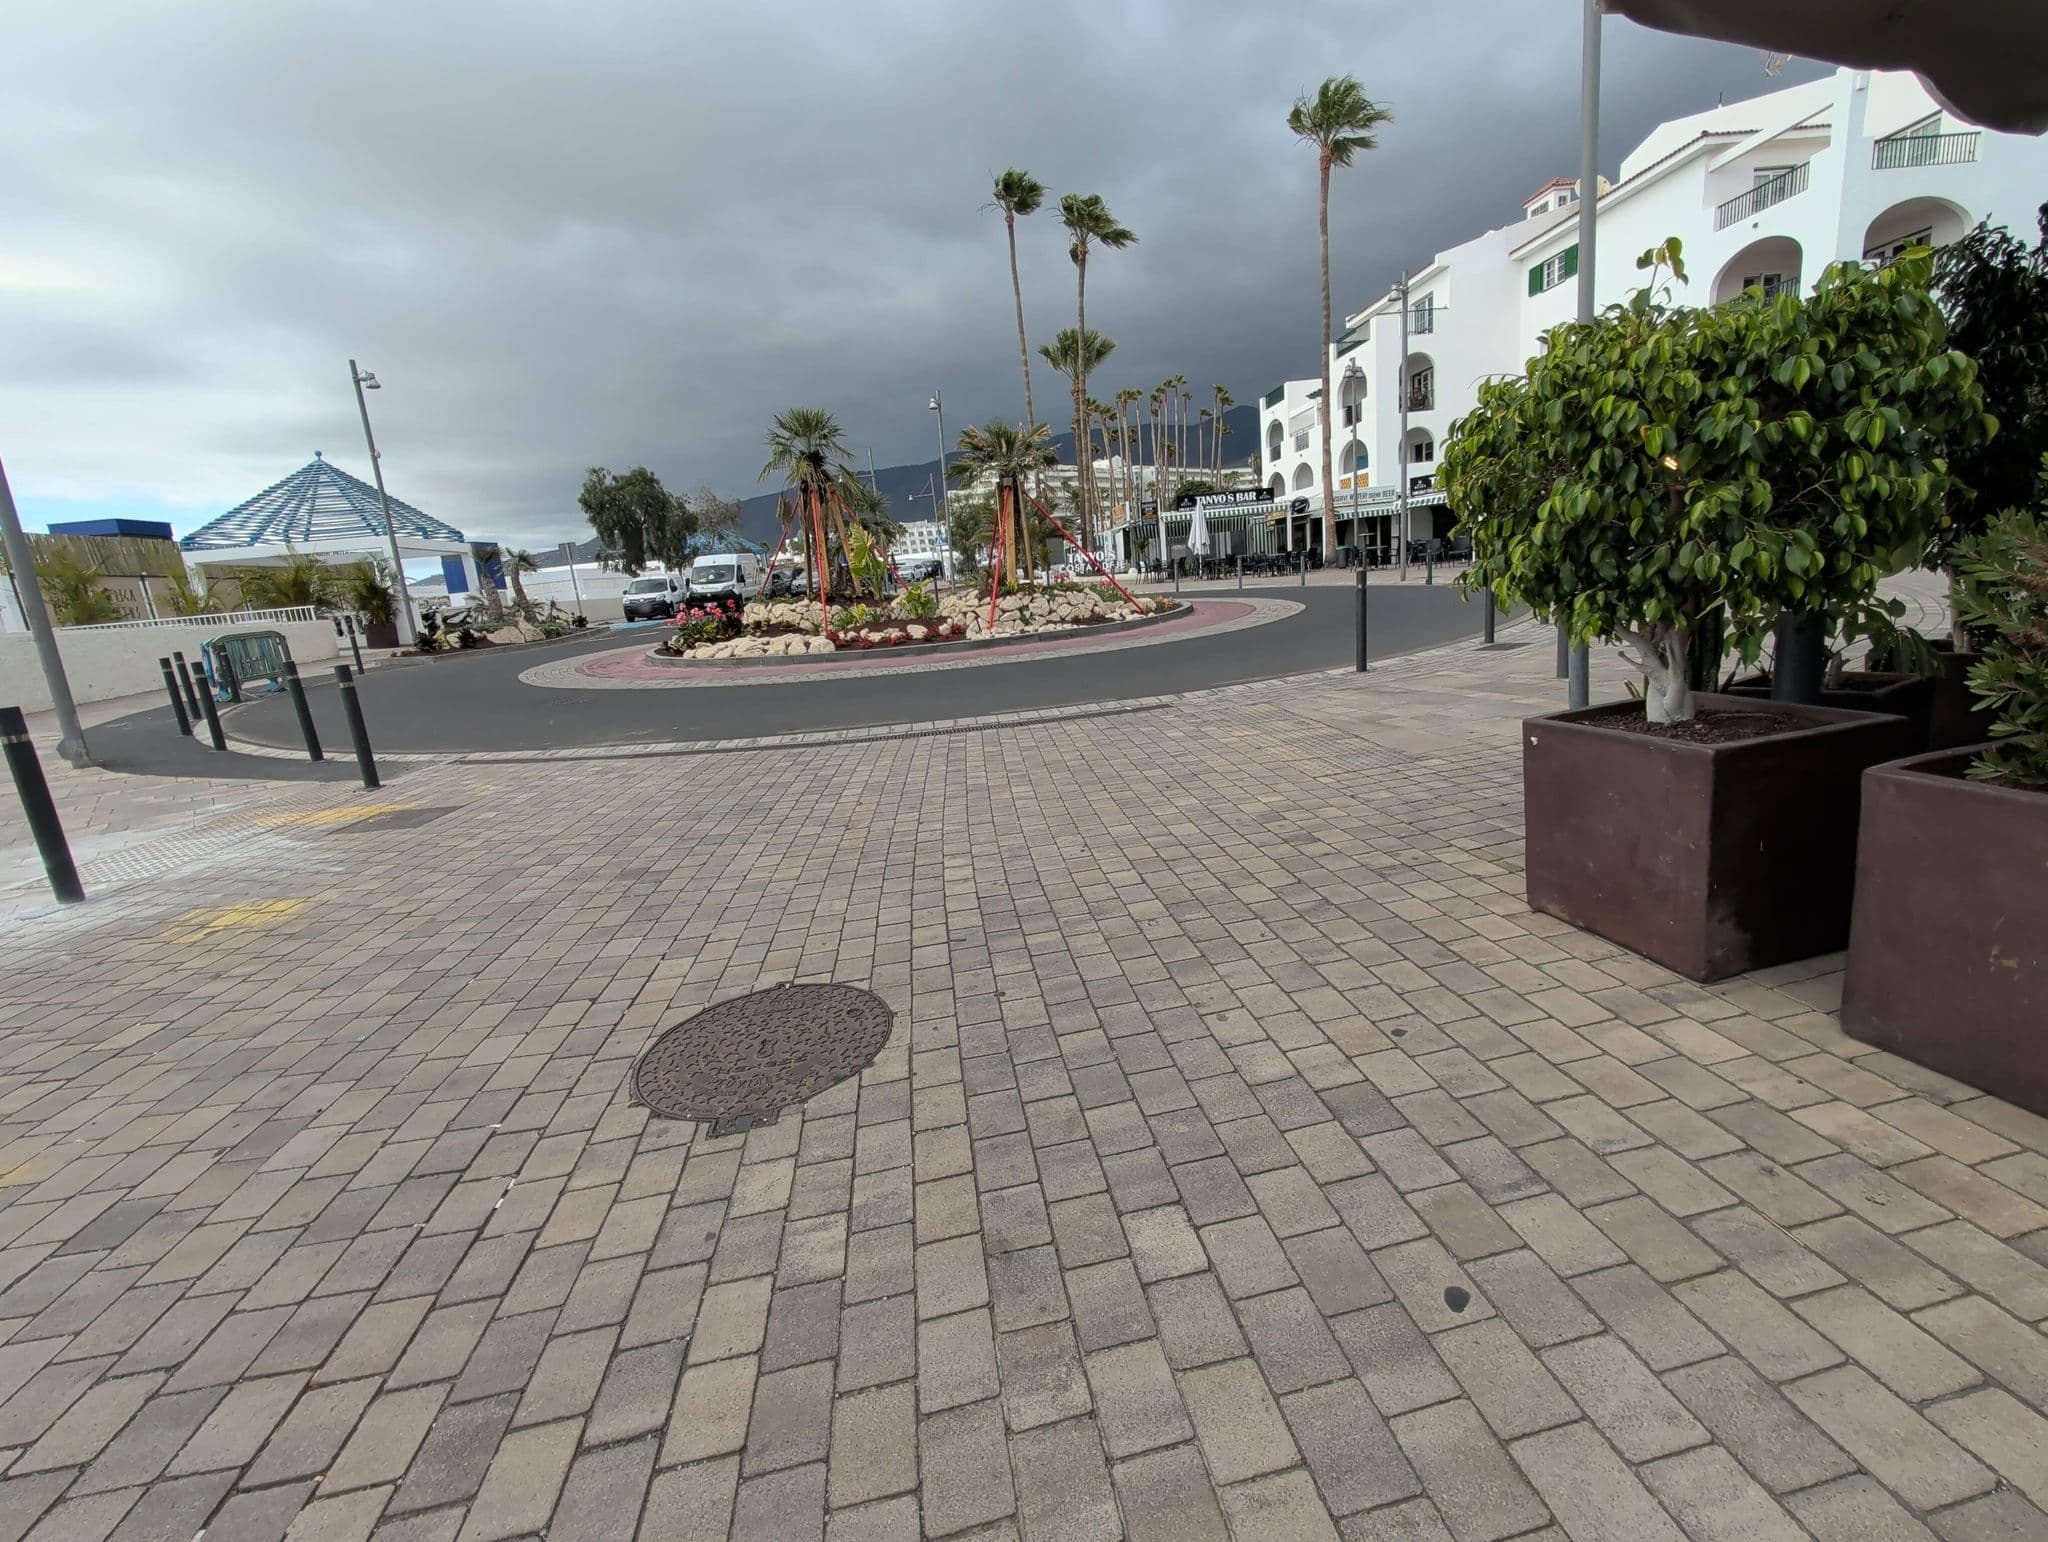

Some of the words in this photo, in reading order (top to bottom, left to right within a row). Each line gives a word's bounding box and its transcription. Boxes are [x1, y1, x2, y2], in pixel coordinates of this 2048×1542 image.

[1194, 491, 1234, 505] TANYO'S
[1236, 491, 1257, 502] BAR
[1066, 549, 1116, 563] TAYOS
[1095, 559, 1126, 571] DEJE
